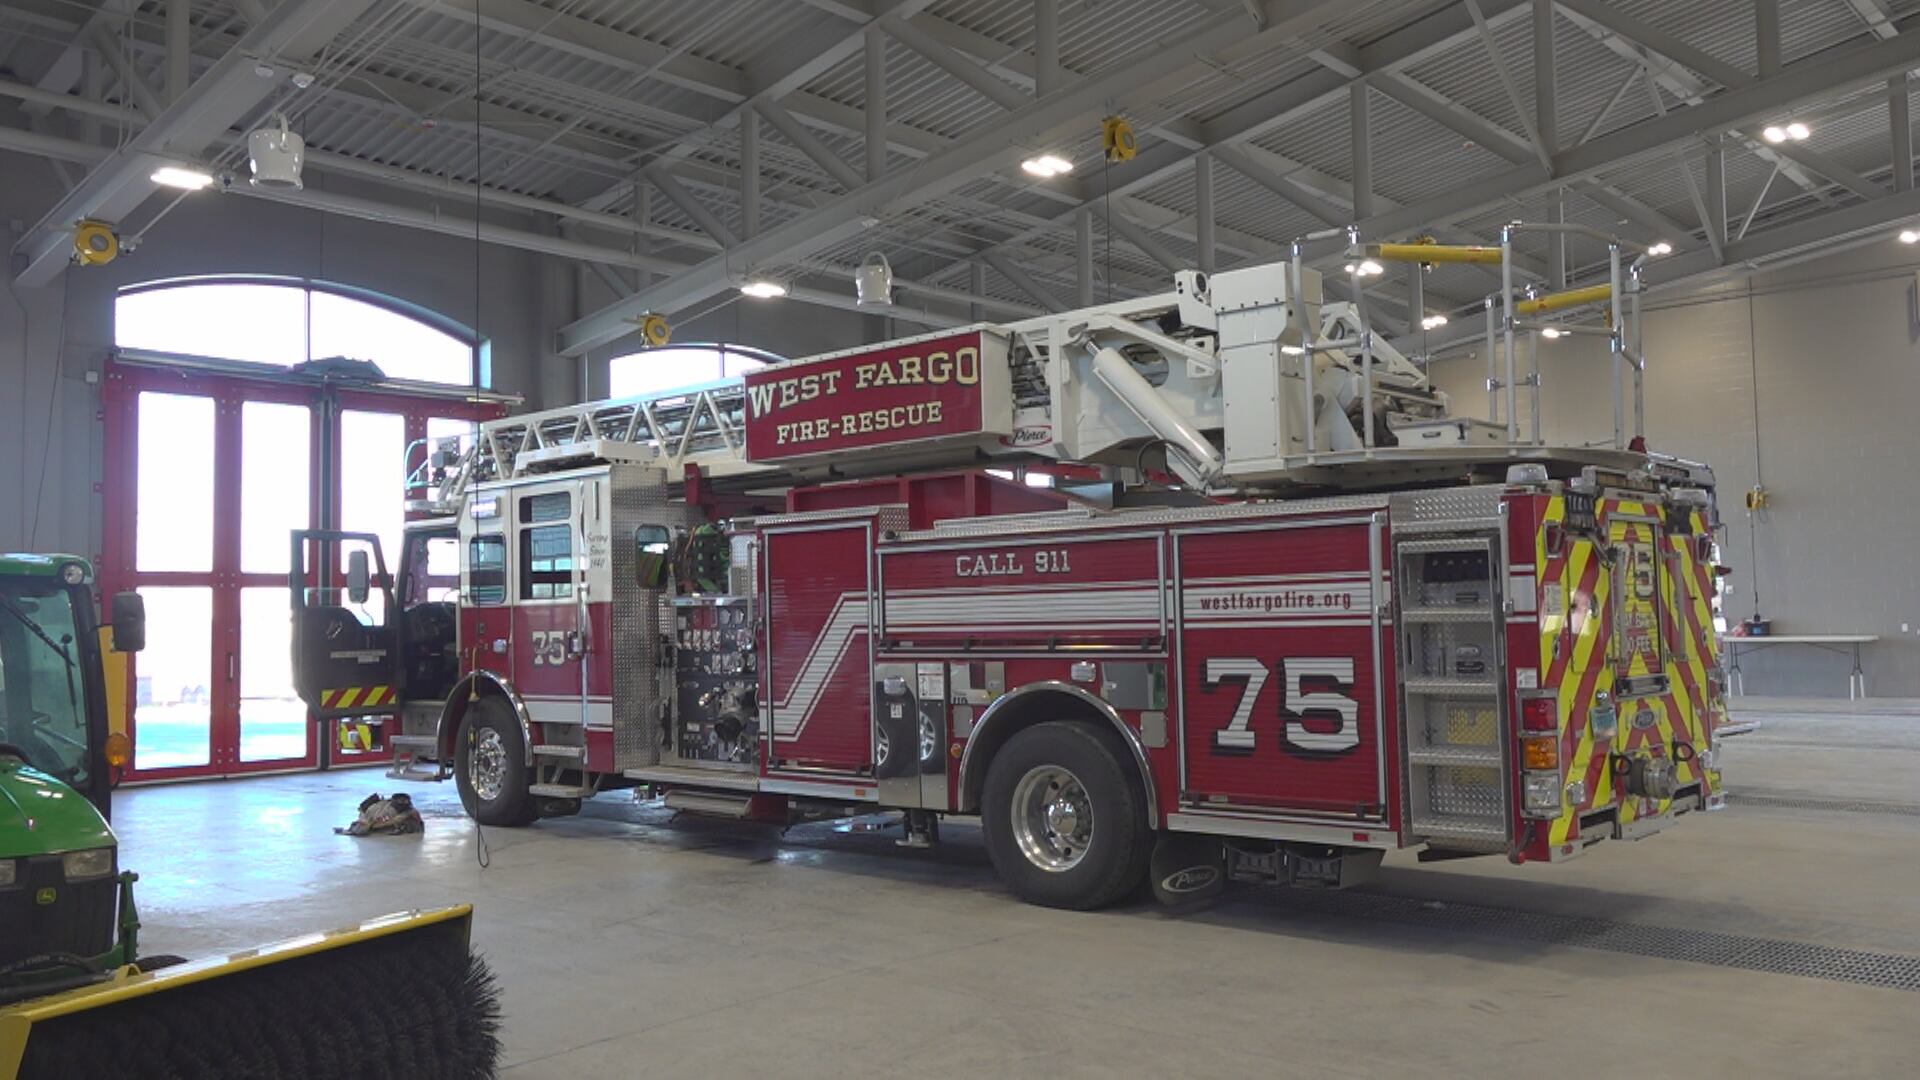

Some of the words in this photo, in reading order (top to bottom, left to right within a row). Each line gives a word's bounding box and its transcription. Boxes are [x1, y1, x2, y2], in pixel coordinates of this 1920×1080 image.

[748, 369, 841, 419] WEST
[855, 347, 979, 389] FARGO
[776, 400, 943, 445] FIRE-RESCUE
[956, 553, 1024, 577] CALL
[1034, 550, 1071, 573] 911
[1200, 591, 1351, 612] westfargofire.org
[532, 631, 565, 665] 75
[1204, 656, 1360, 756] 75
